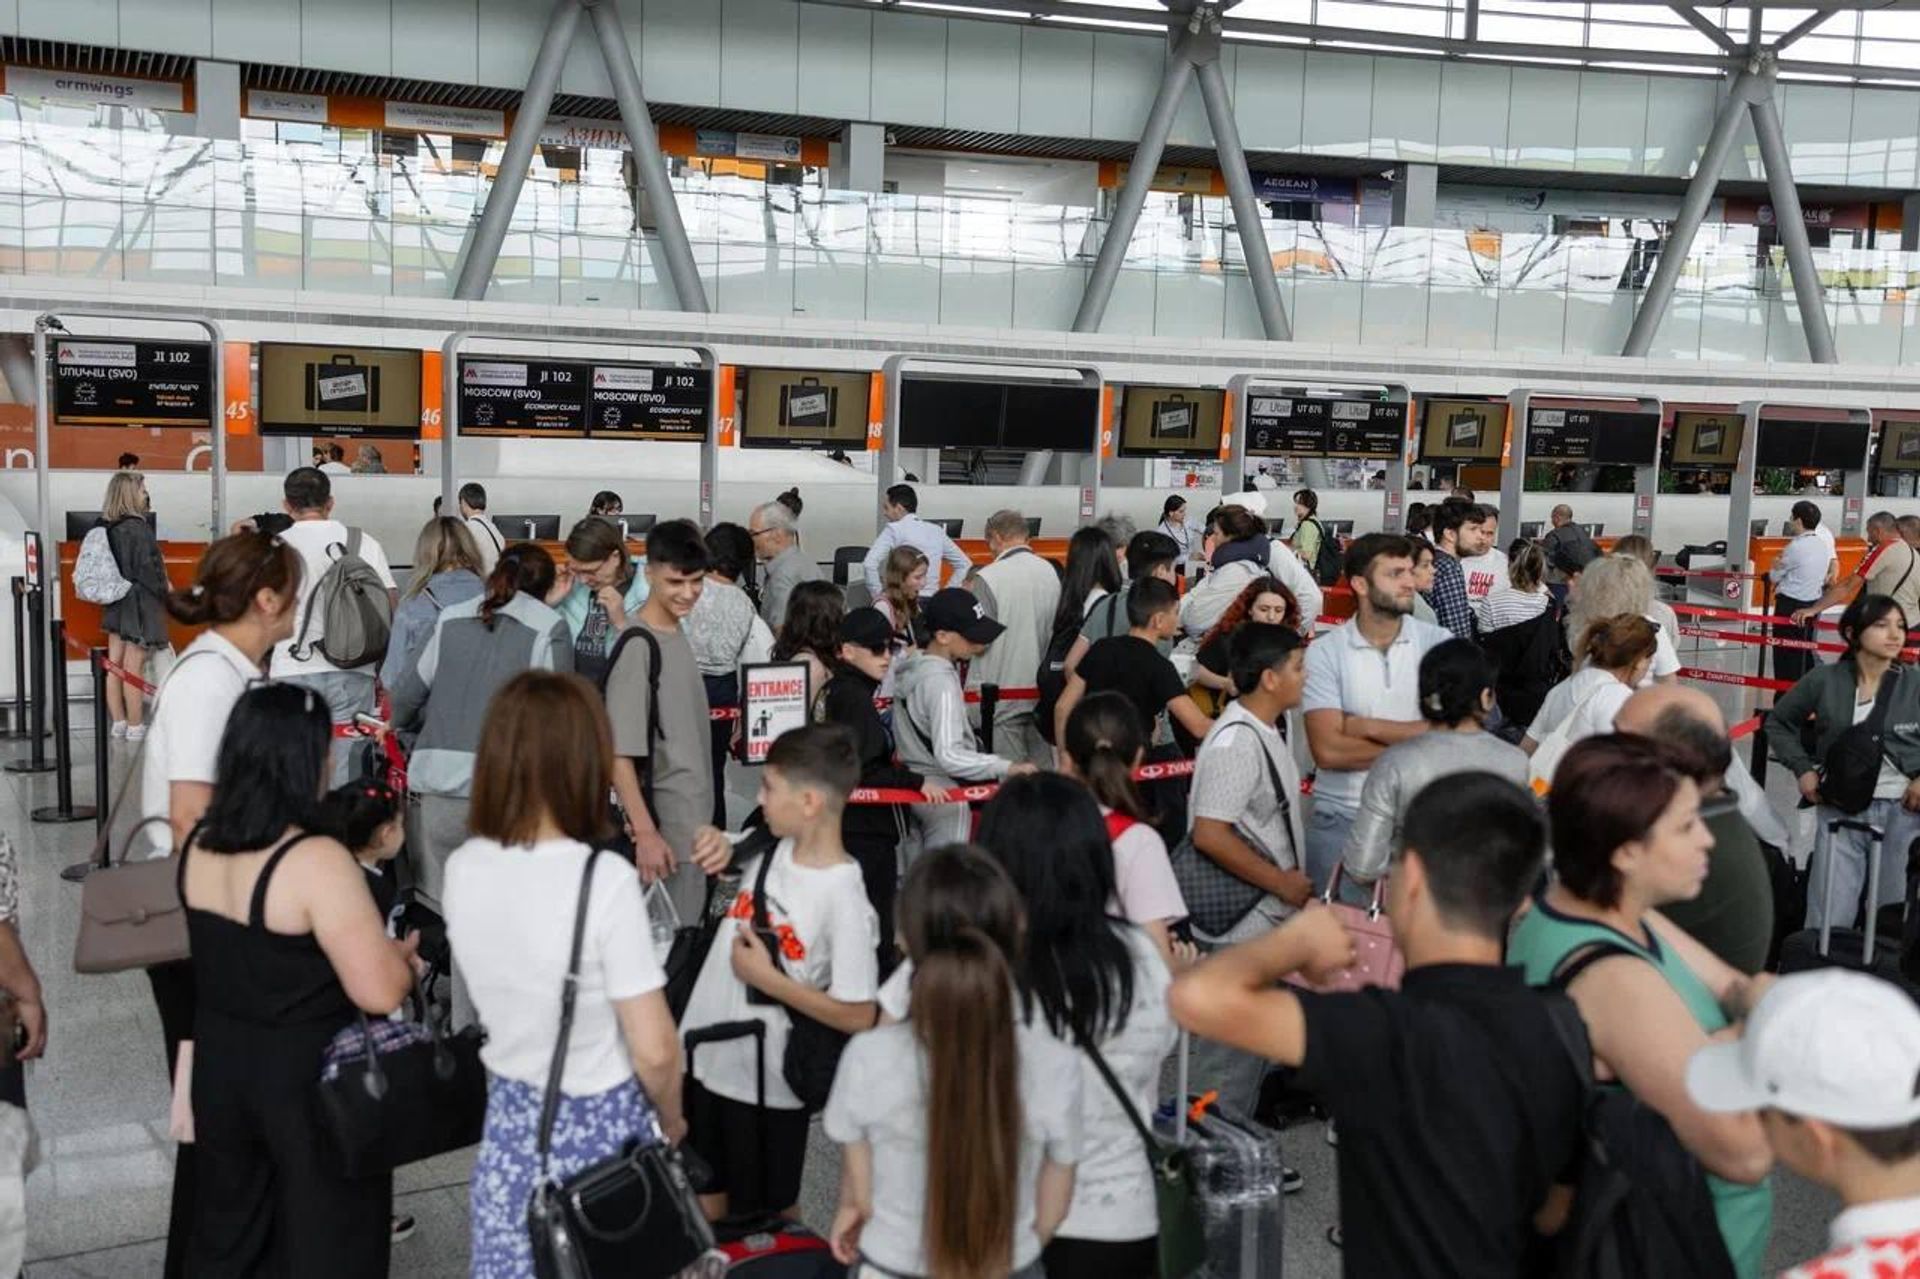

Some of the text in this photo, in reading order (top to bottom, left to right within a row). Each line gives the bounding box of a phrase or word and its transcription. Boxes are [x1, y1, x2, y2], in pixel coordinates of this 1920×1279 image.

[55, 78, 134, 98] armwings
[1263, 178, 1309, 189] AEGEAN
[168, 352, 190, 363] 102
[108, 368, 138, 380] (SVO)
[553, 371, 572, 382] 102
[676, 376, 695, 387] 102
[464, 388, 541, 400] MOSCOW (SVO)
[594, 391, 666, 404] MOSCOW (SVO)
[226, 401, 249, 420] 45
[559, 403, 582, 411] CLASS
[421, 408, 441, 426] 46
[1103, 432, 1111, 447] 9
[1221, 432, 1231, 449] 0
[1504, 441, 1511, 457] 2
[1783, 639, 1818, 649] ZVARTNOTS
[748, 680, 803, 696] ENTRANCE
